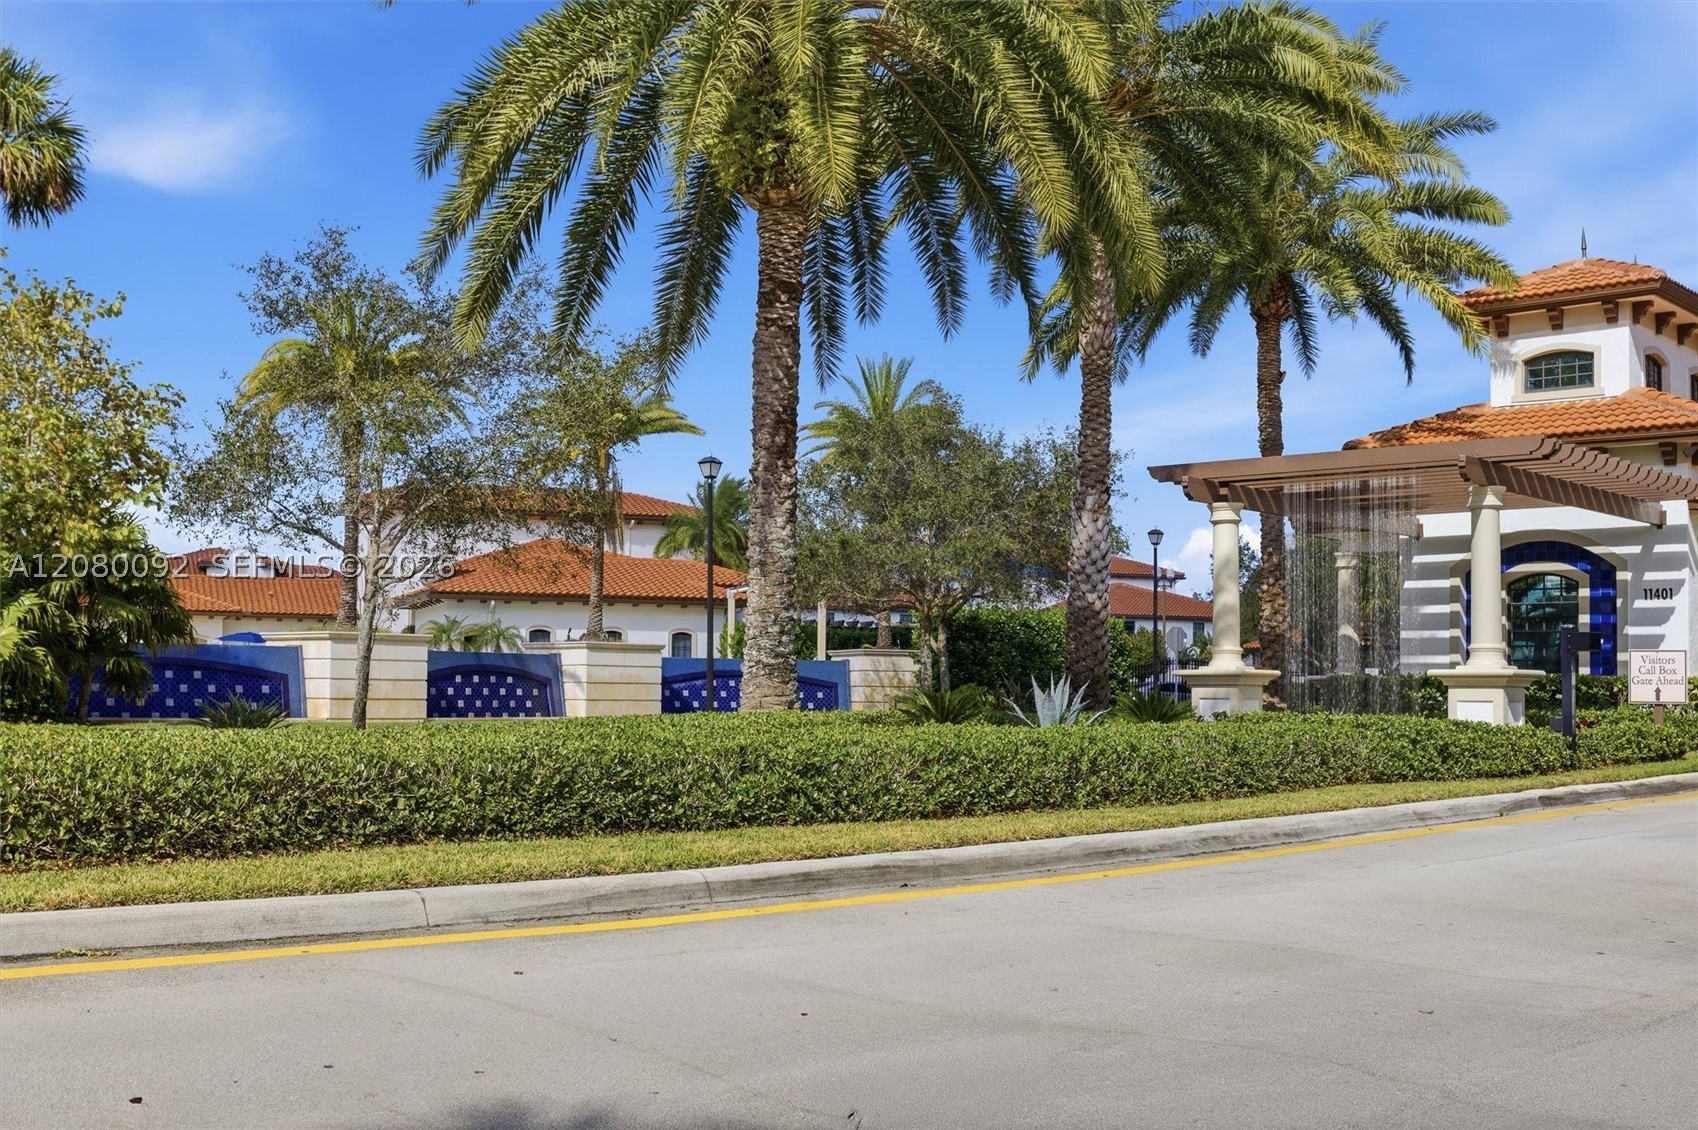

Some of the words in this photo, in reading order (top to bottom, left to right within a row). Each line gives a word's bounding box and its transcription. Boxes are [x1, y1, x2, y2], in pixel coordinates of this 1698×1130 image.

[1642, 587, 1674, 601] 11401
[1640, 655, 1676, 665] Visitors
[1638, 665, 1656, 675] Call
[1658, 665, 1677, 675] Box
[1631, 675, 1653, 686] Gate
[1655, 675, 1685, 686] Ahead
